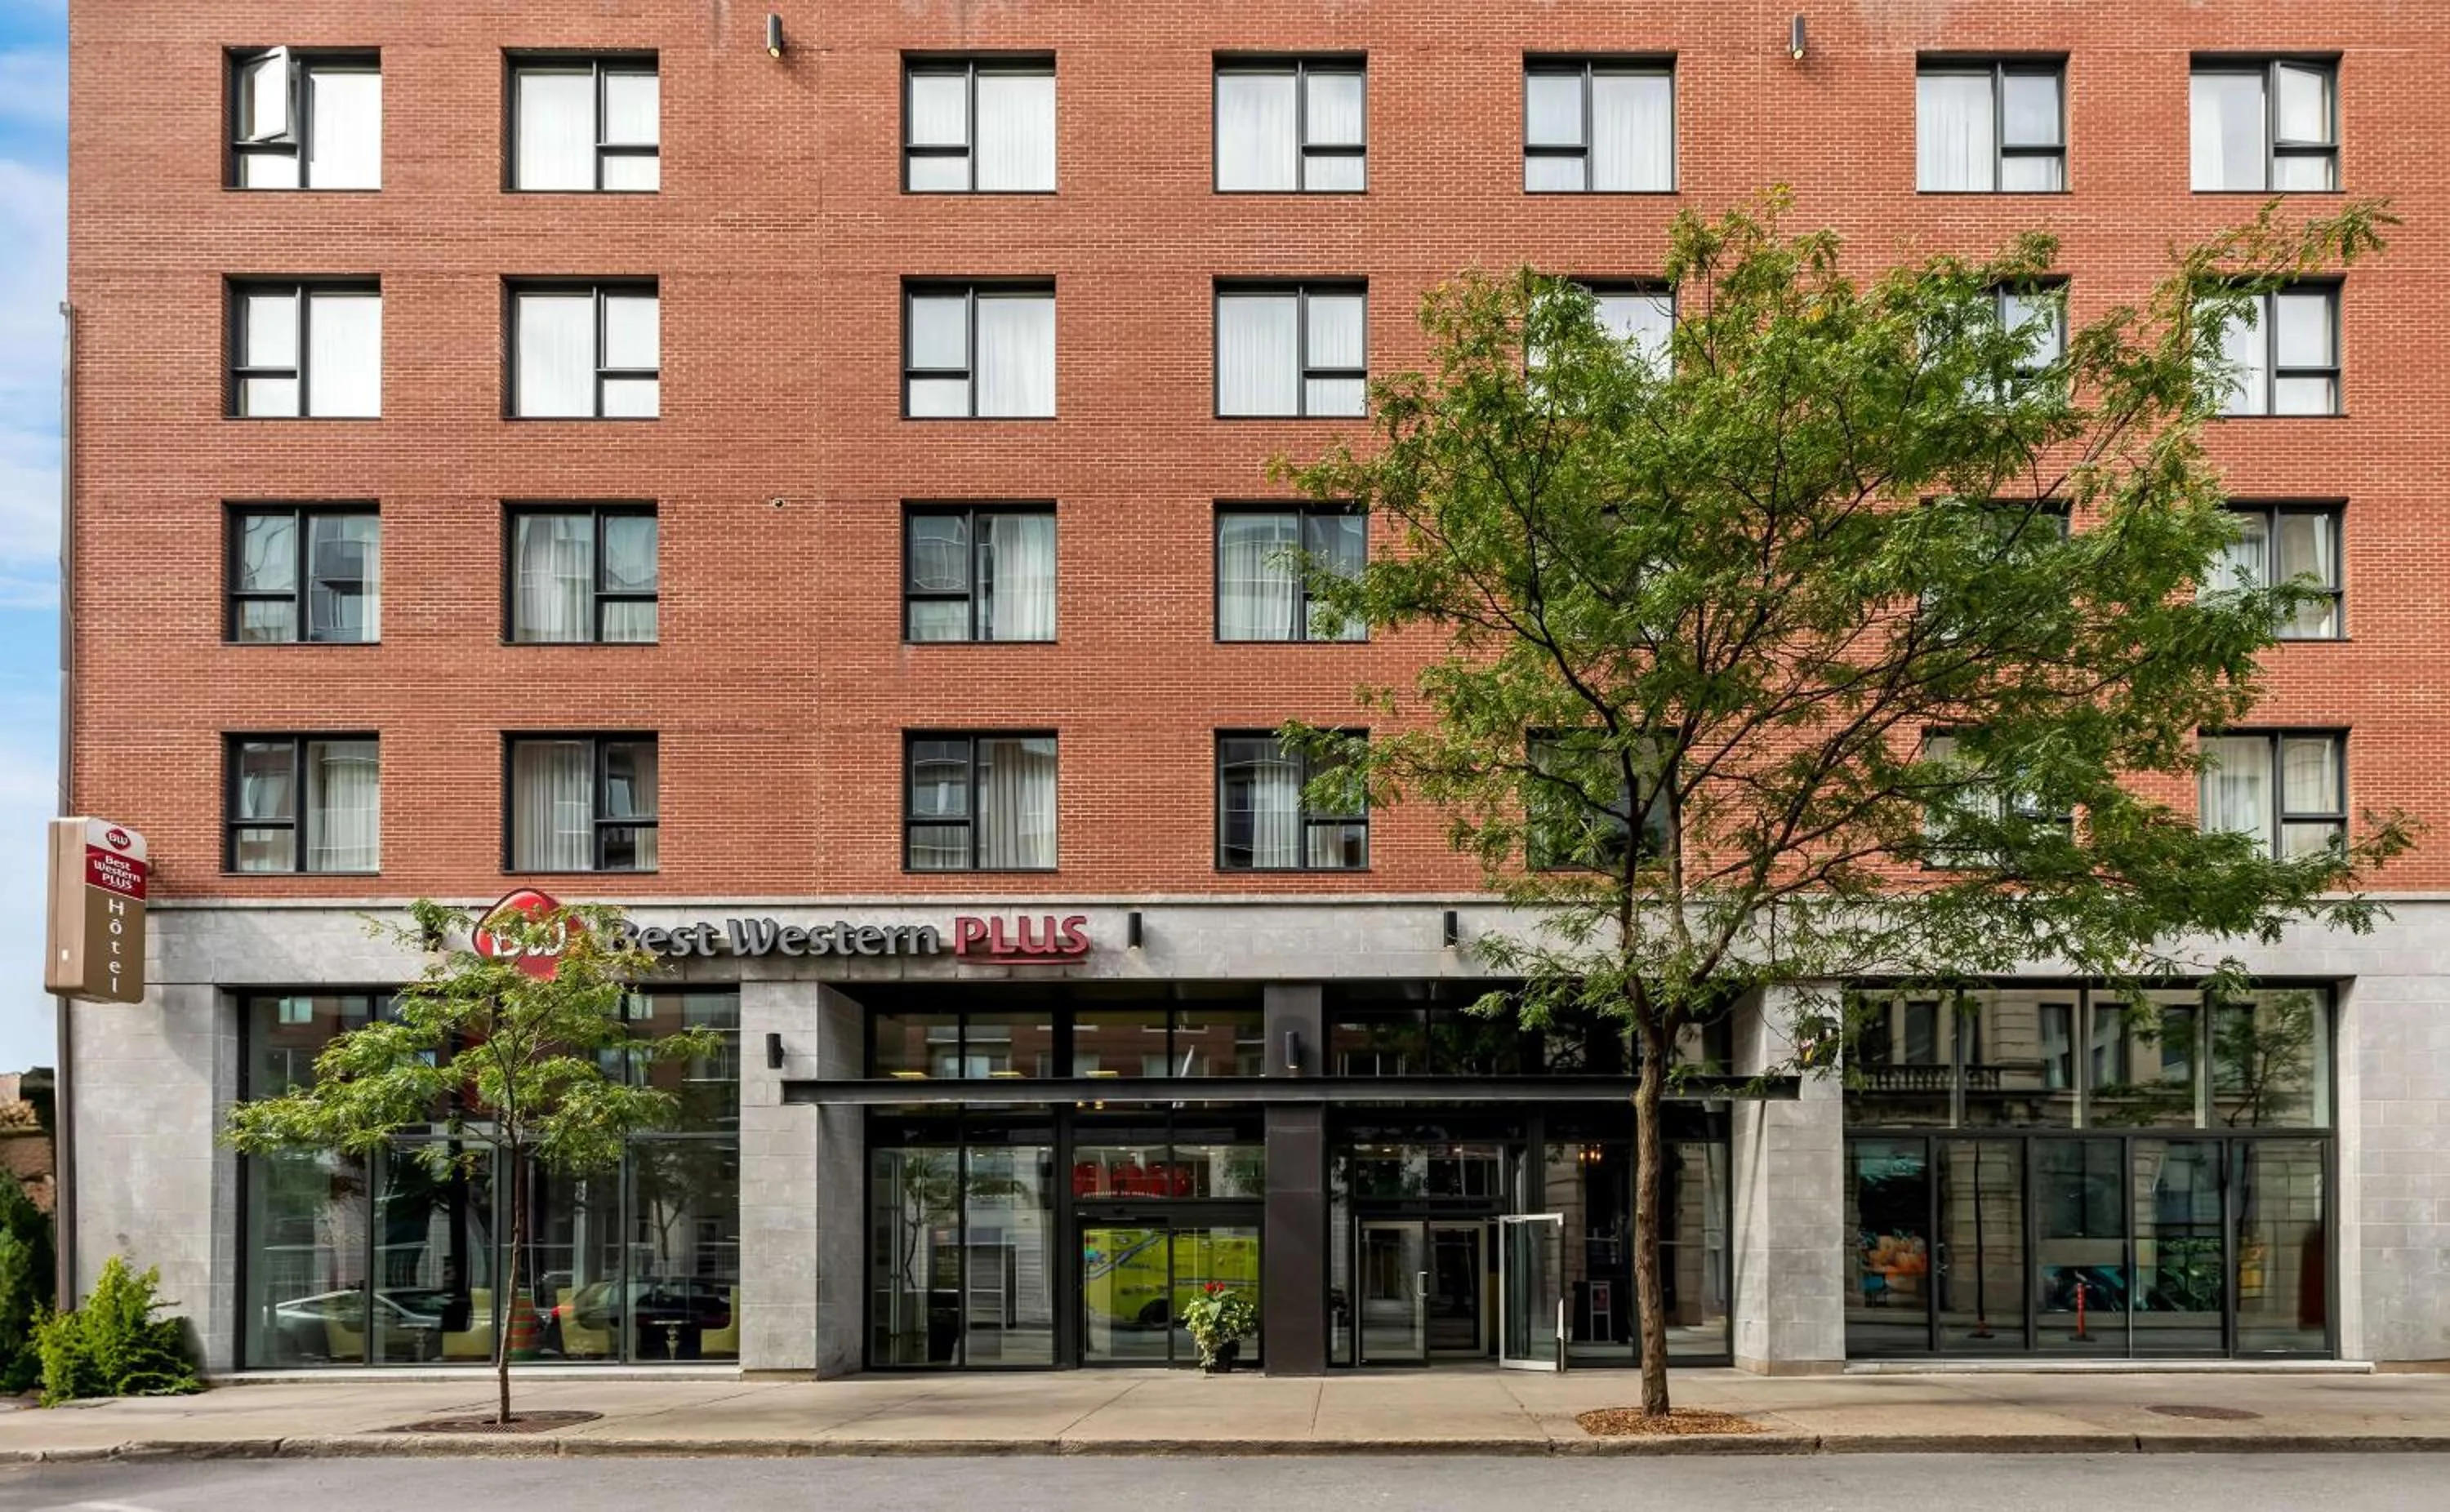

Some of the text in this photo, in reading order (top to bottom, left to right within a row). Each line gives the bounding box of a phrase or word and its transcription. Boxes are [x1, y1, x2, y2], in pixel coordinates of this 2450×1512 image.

[109, 832, 128, 845] BW
[94, 860, 141, 883] Western
[105, 855, 131, 870] Best
[102, 873, 132, 889] PLUS
[607, 915, 1091, 956] Best Western PLUS
[108, 898, 124, 993] Hôtel
